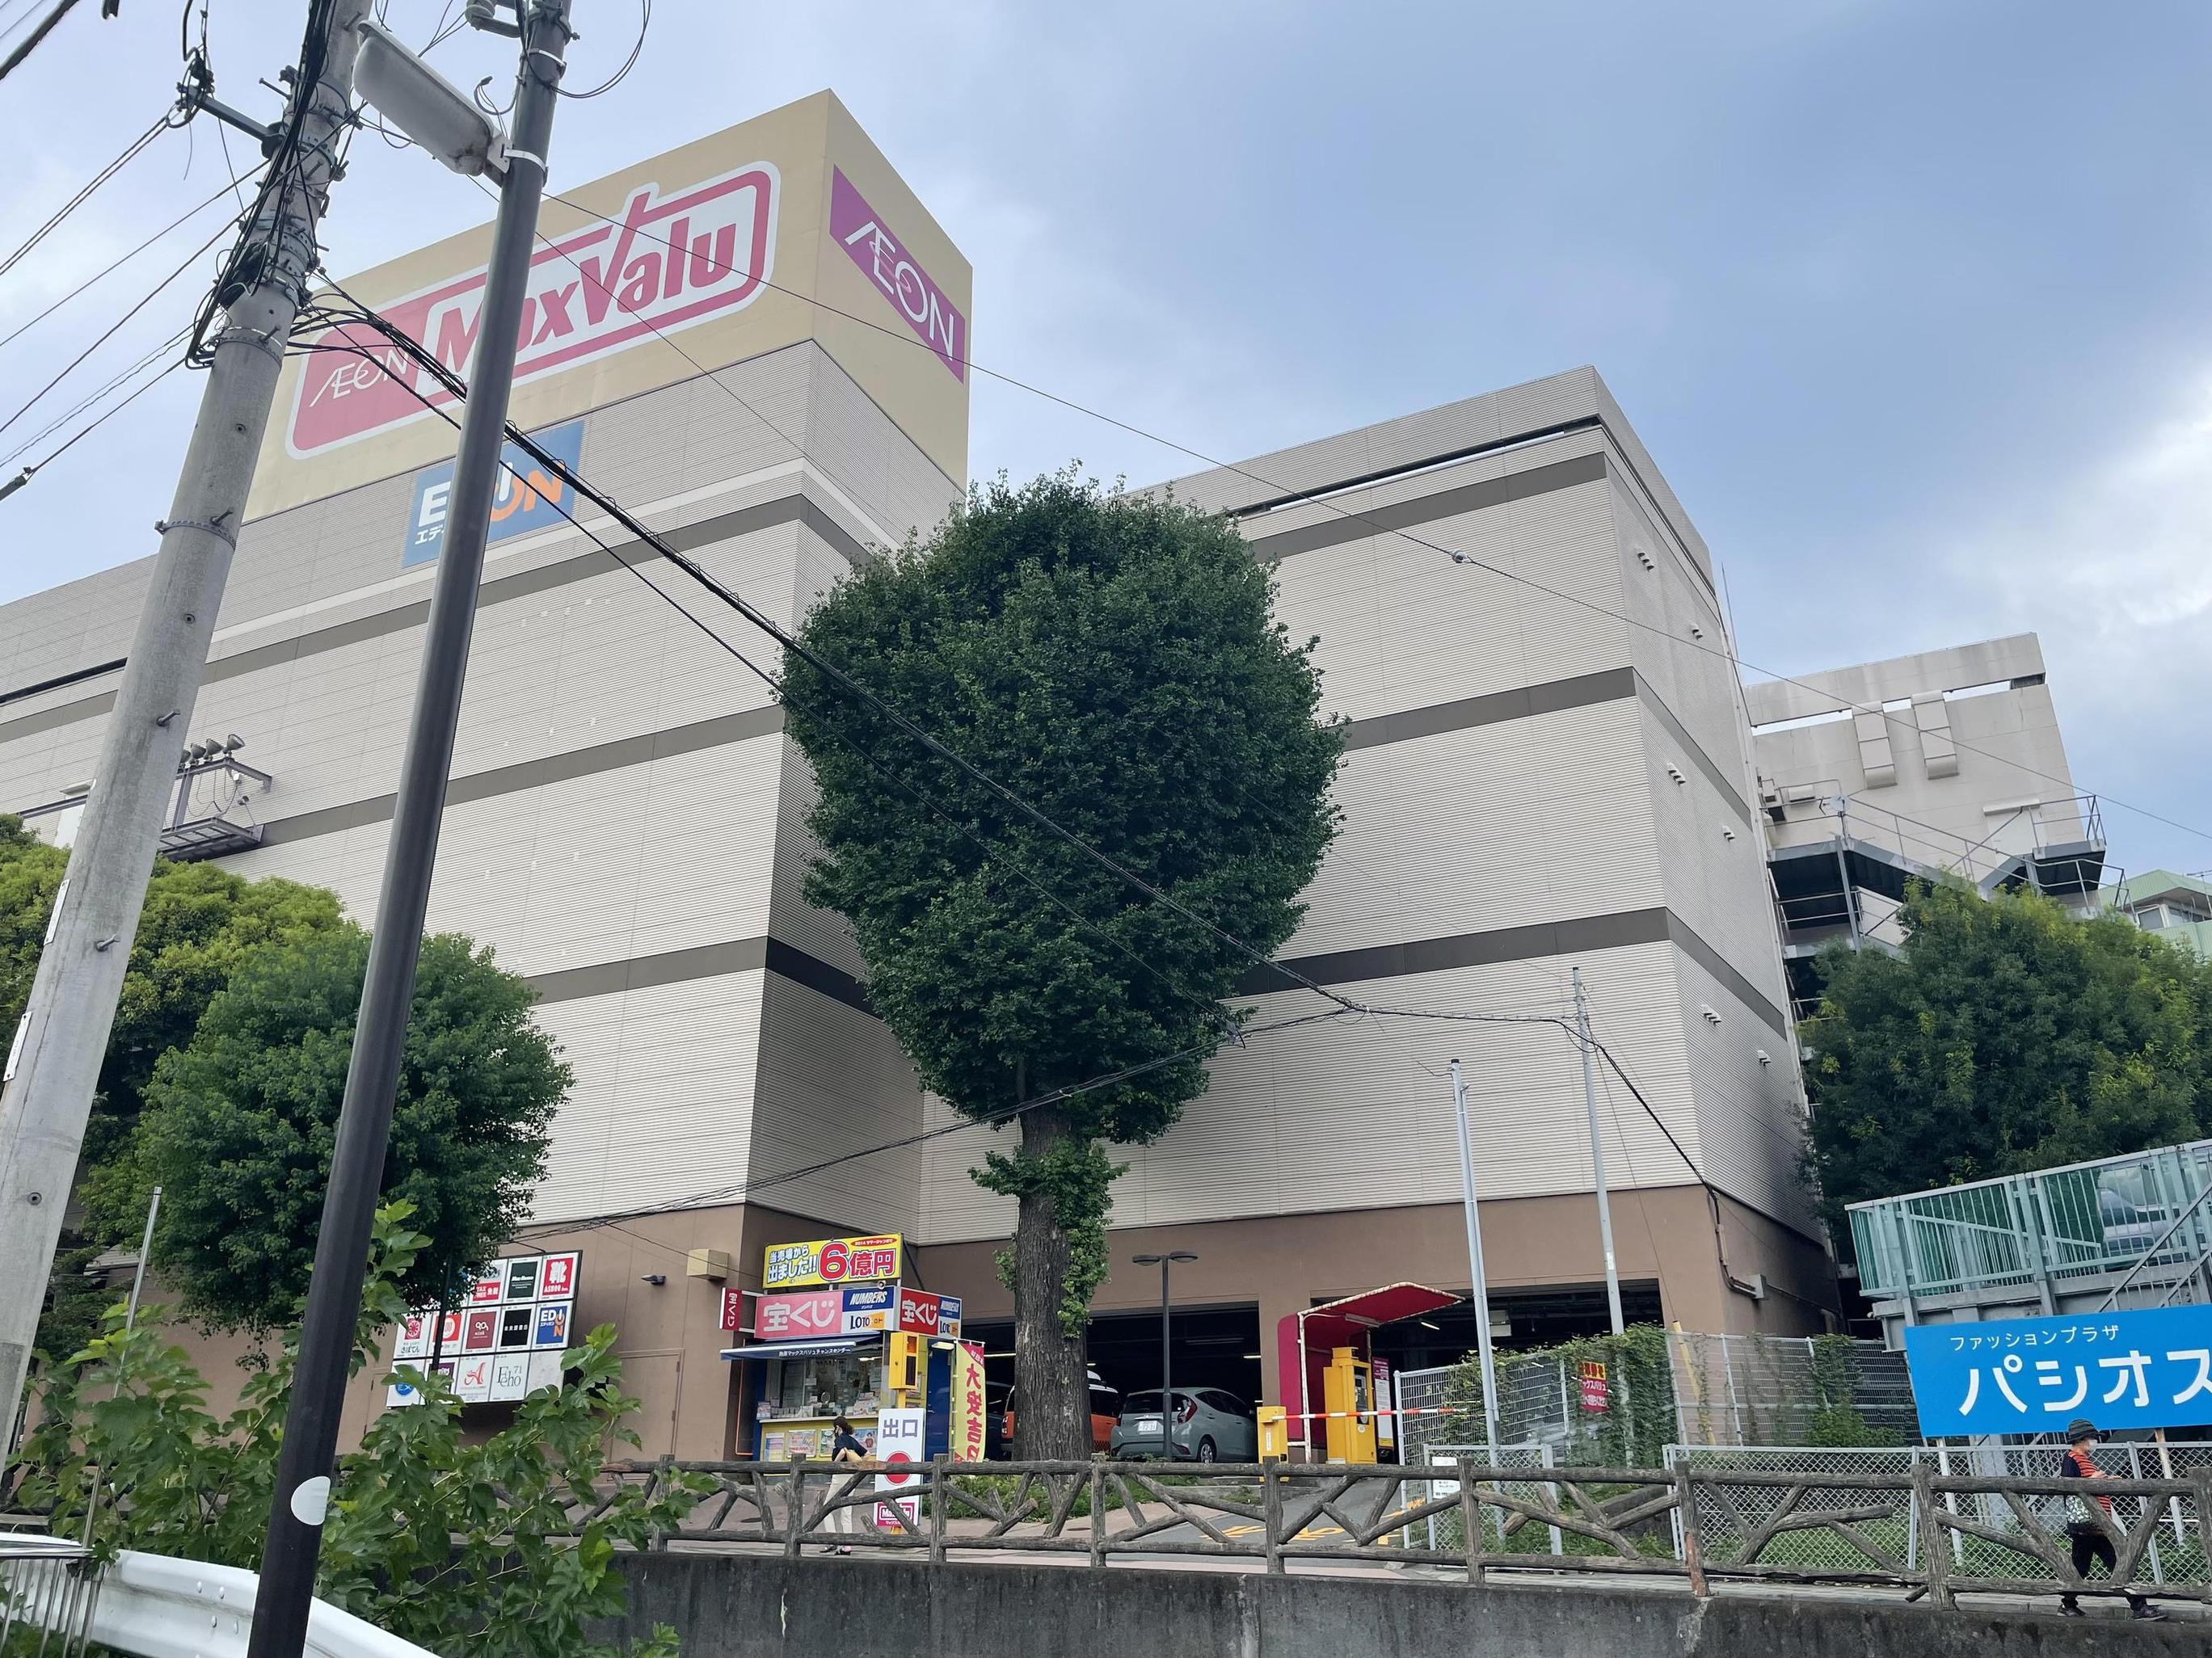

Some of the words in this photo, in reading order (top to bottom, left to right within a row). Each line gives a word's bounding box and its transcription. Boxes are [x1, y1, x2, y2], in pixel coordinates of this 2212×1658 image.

[418, 461, 563, 528] EION
[769, 1244, 810, 1264] 当売場から
[728, 1292, 738, 1327] 宝くじ
[849, 1291, 887, 1306] NUMBERS
[763, 1299, 836, 1332] 宝くじ
[850, 1315, 870, 1330] LOTO
[901, 1299, 937, 1326] 宝くじ
[1949, 1324, 2120, 1352] ファッションプラザ
[1958, 1349, 2212, 1416] パシオス
[883, 1418, 918, 1438] 出口
